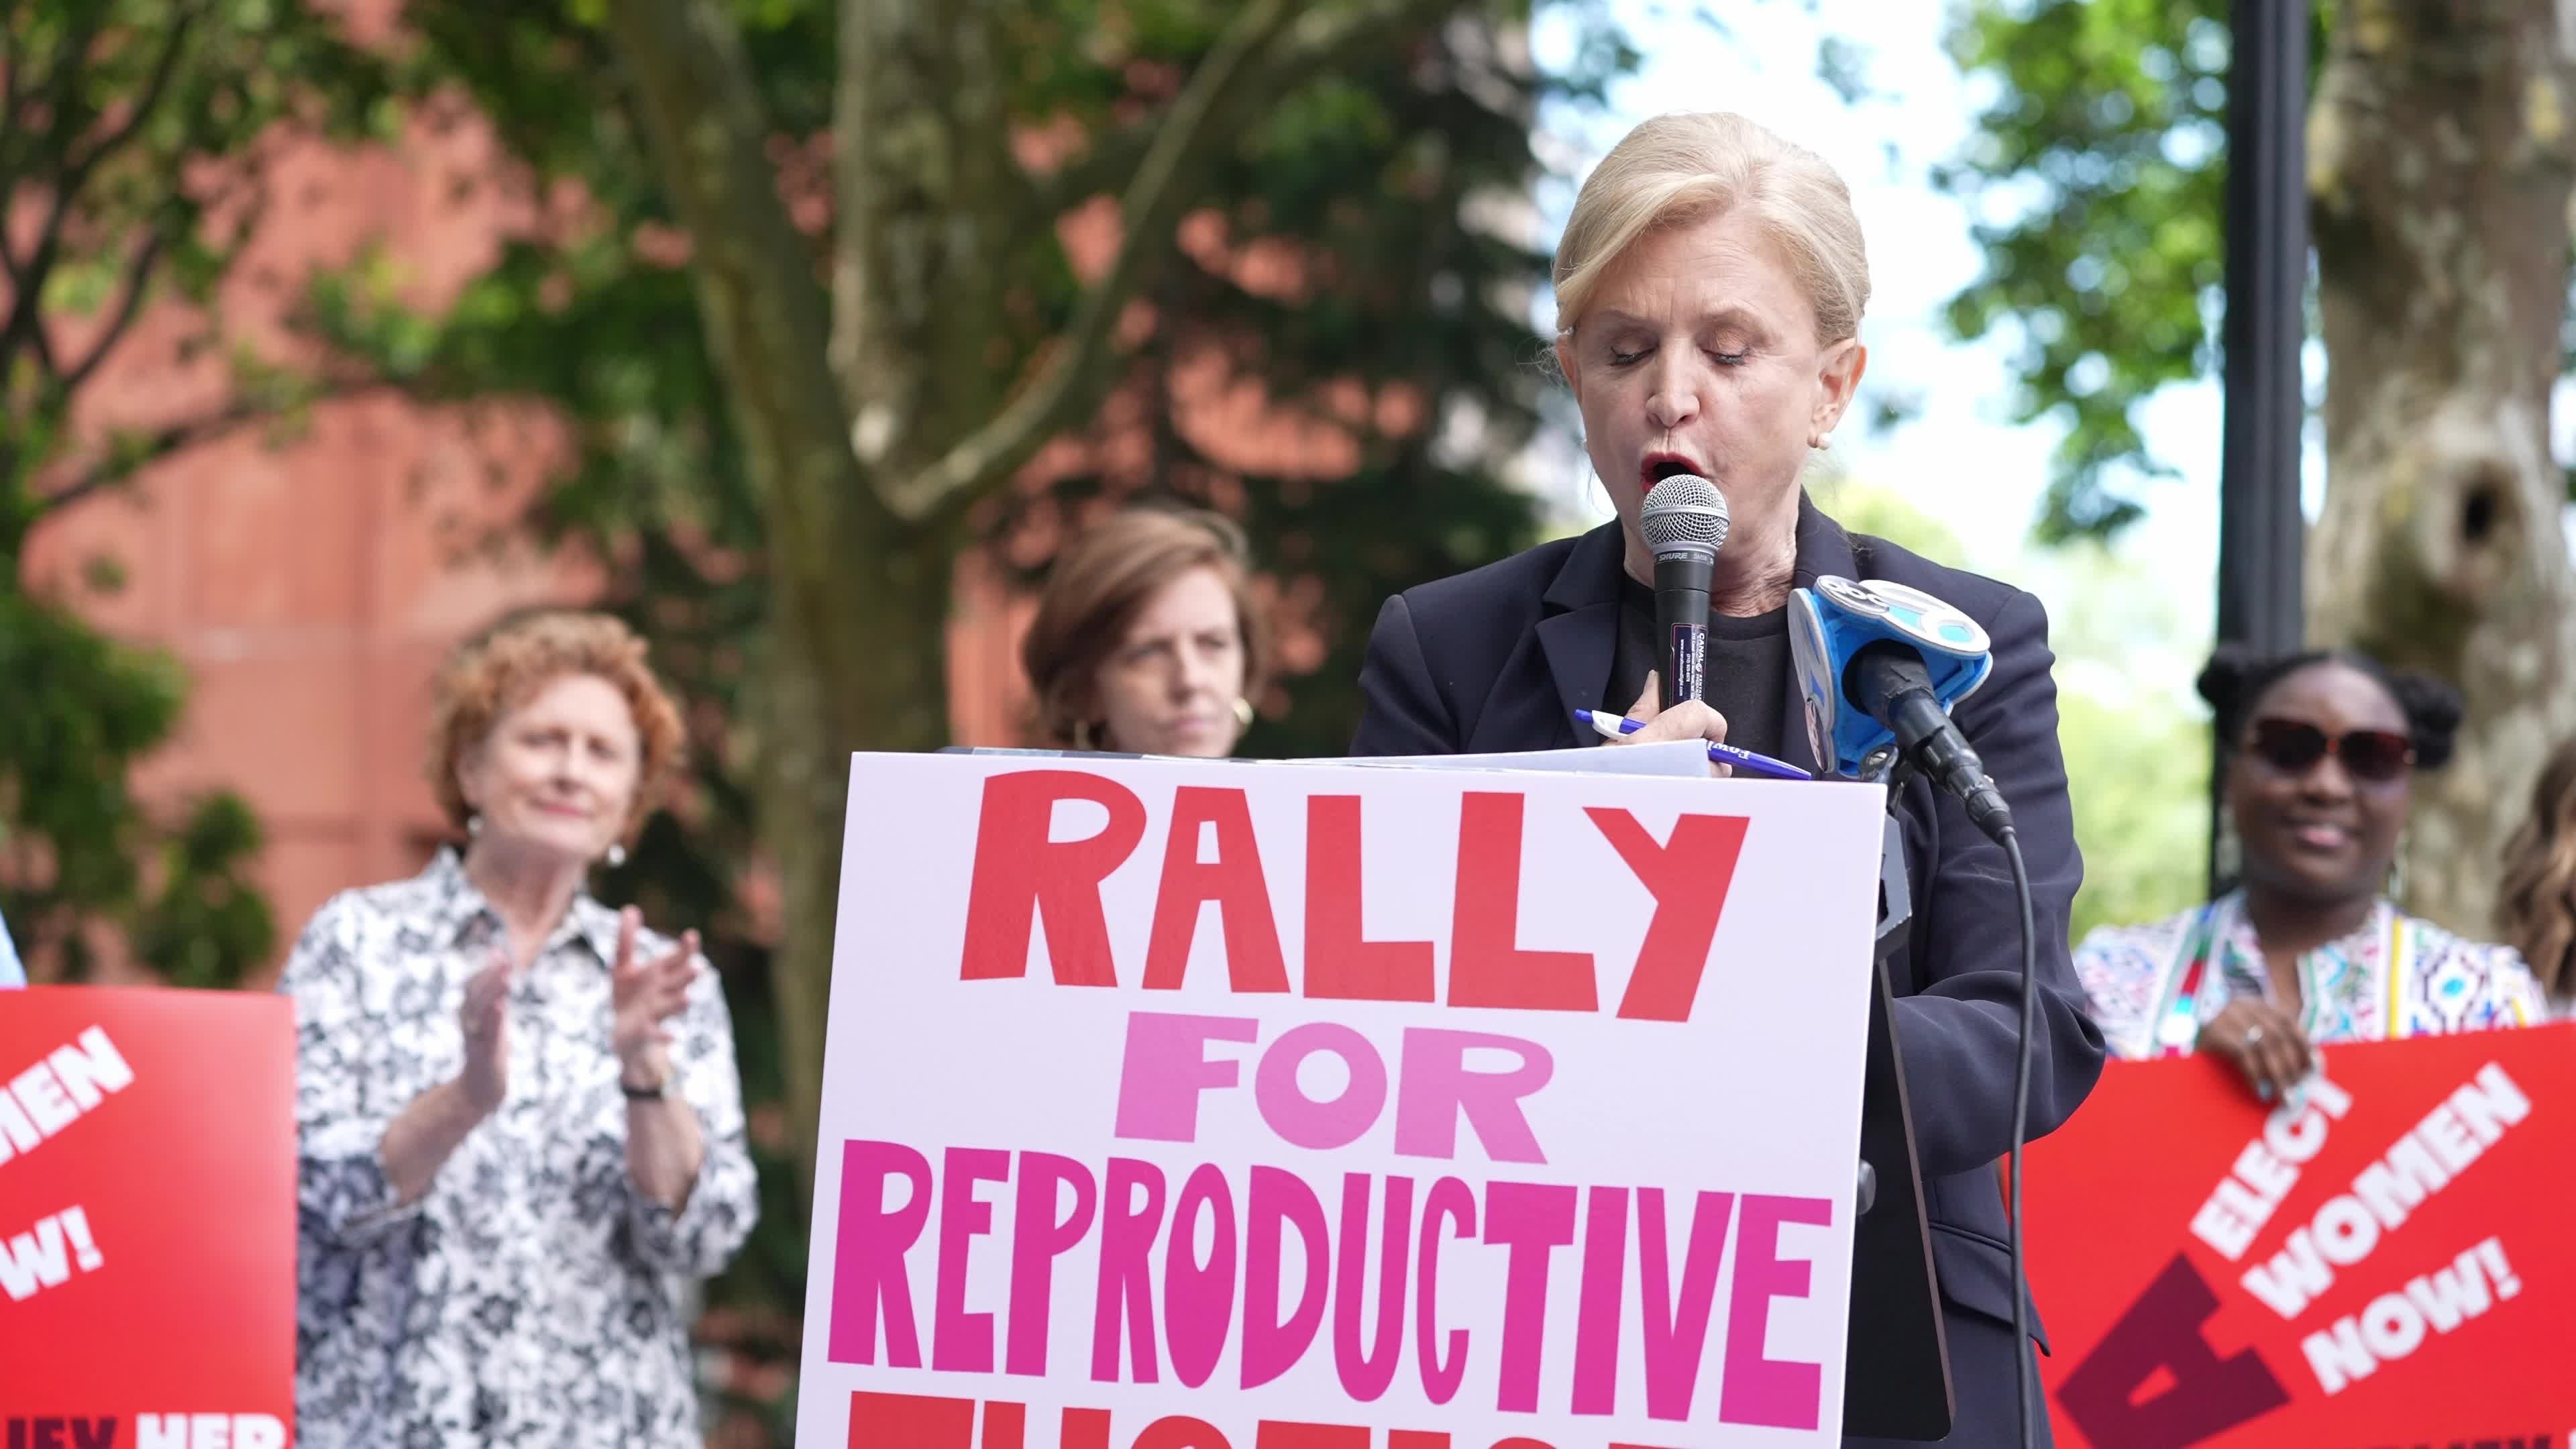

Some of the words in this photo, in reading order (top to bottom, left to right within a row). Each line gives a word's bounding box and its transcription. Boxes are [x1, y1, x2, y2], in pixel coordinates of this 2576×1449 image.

[1659, 552, 1688, 561] SHURE
[1824, 582, 1889, 607] abc
[960, 769, 1750, 1022] RALLY
[1116, 1012, 1553, 1163] FOR
[2190, 1048, 2352, 1260] ELECT
[2241, 1063, 2531, 1320] WOMEN
[828, 1138, 1833, 1431] REPRODUCTIVE
[2302, 1237, 2522, 1395] NOW!
